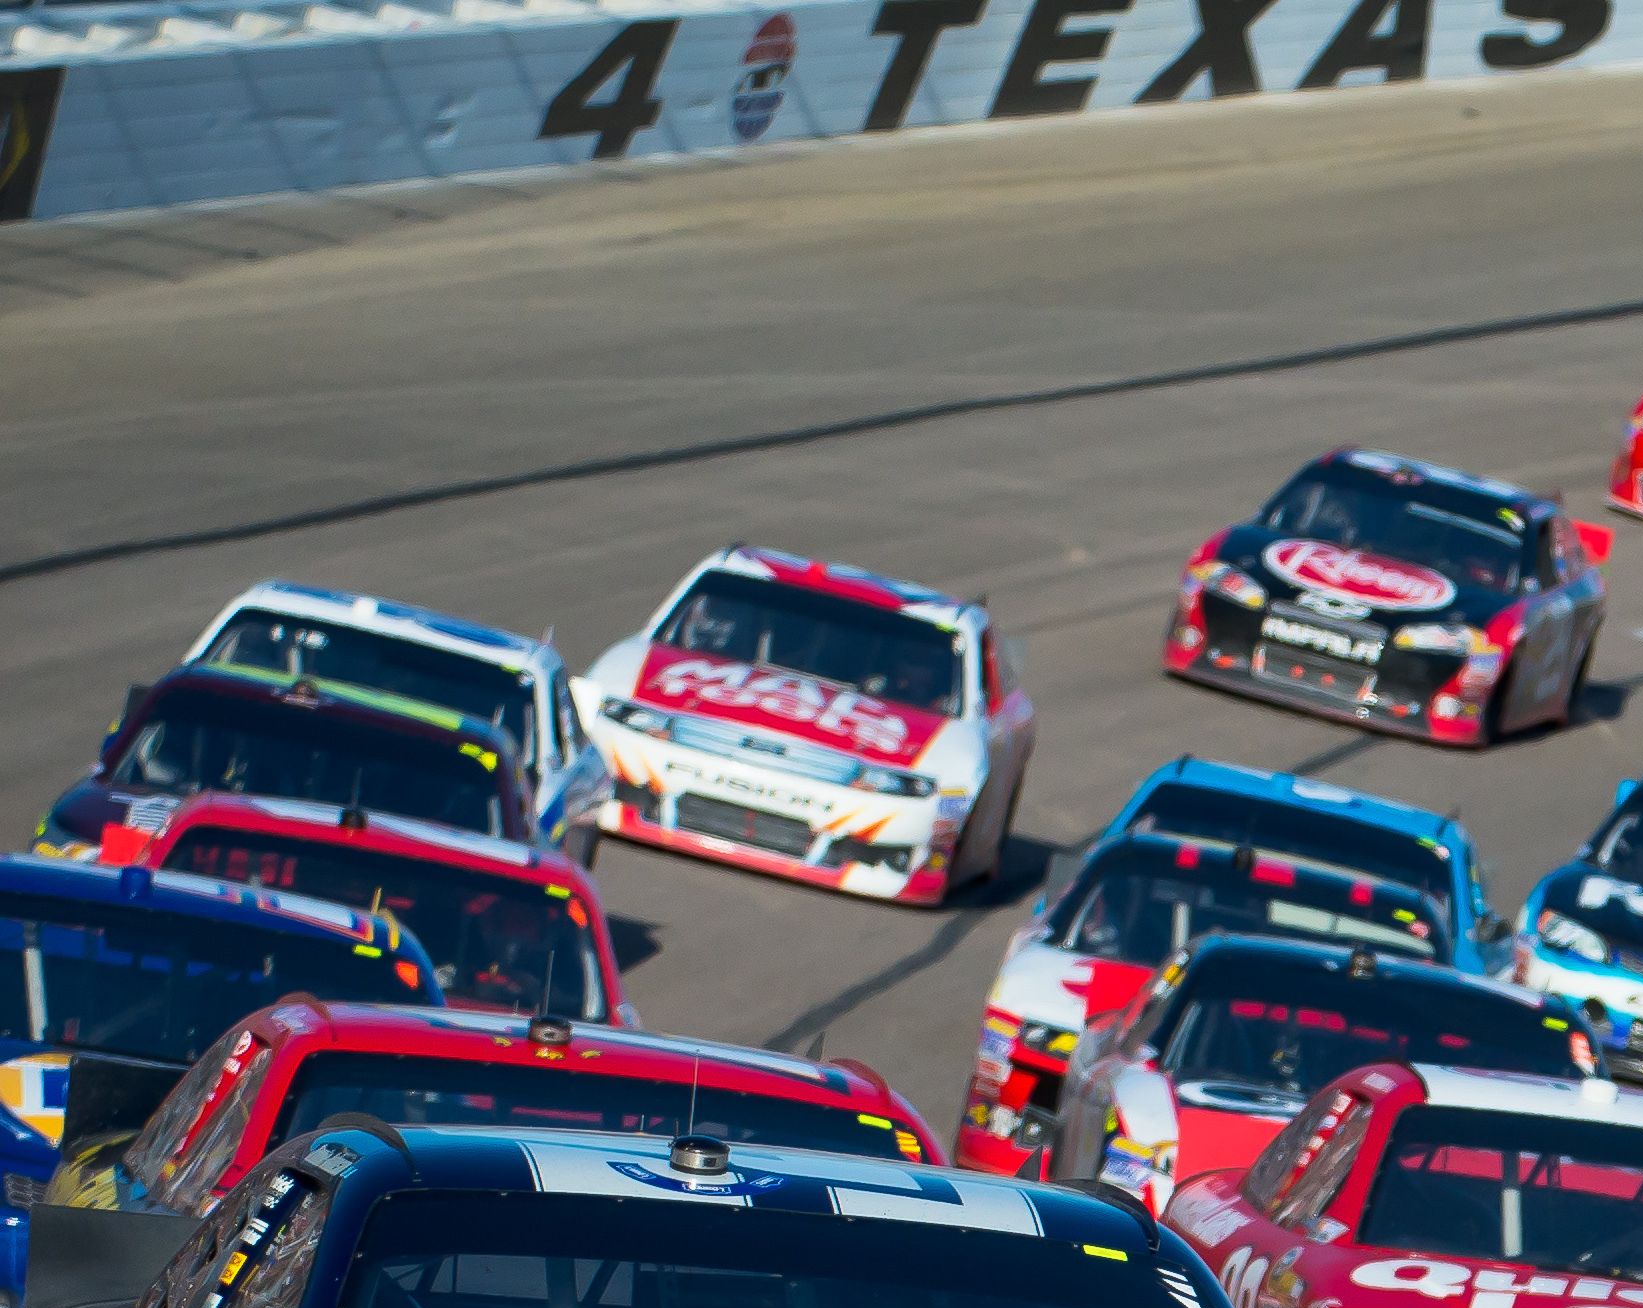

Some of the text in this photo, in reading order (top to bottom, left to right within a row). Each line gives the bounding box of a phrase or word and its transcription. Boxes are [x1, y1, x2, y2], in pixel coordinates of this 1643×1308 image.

[864, 0, 1616, 131] TEXAS
[1284, 542, 1444, 604] Rheem
[1261, 614, 1386, 665] IMPALA
